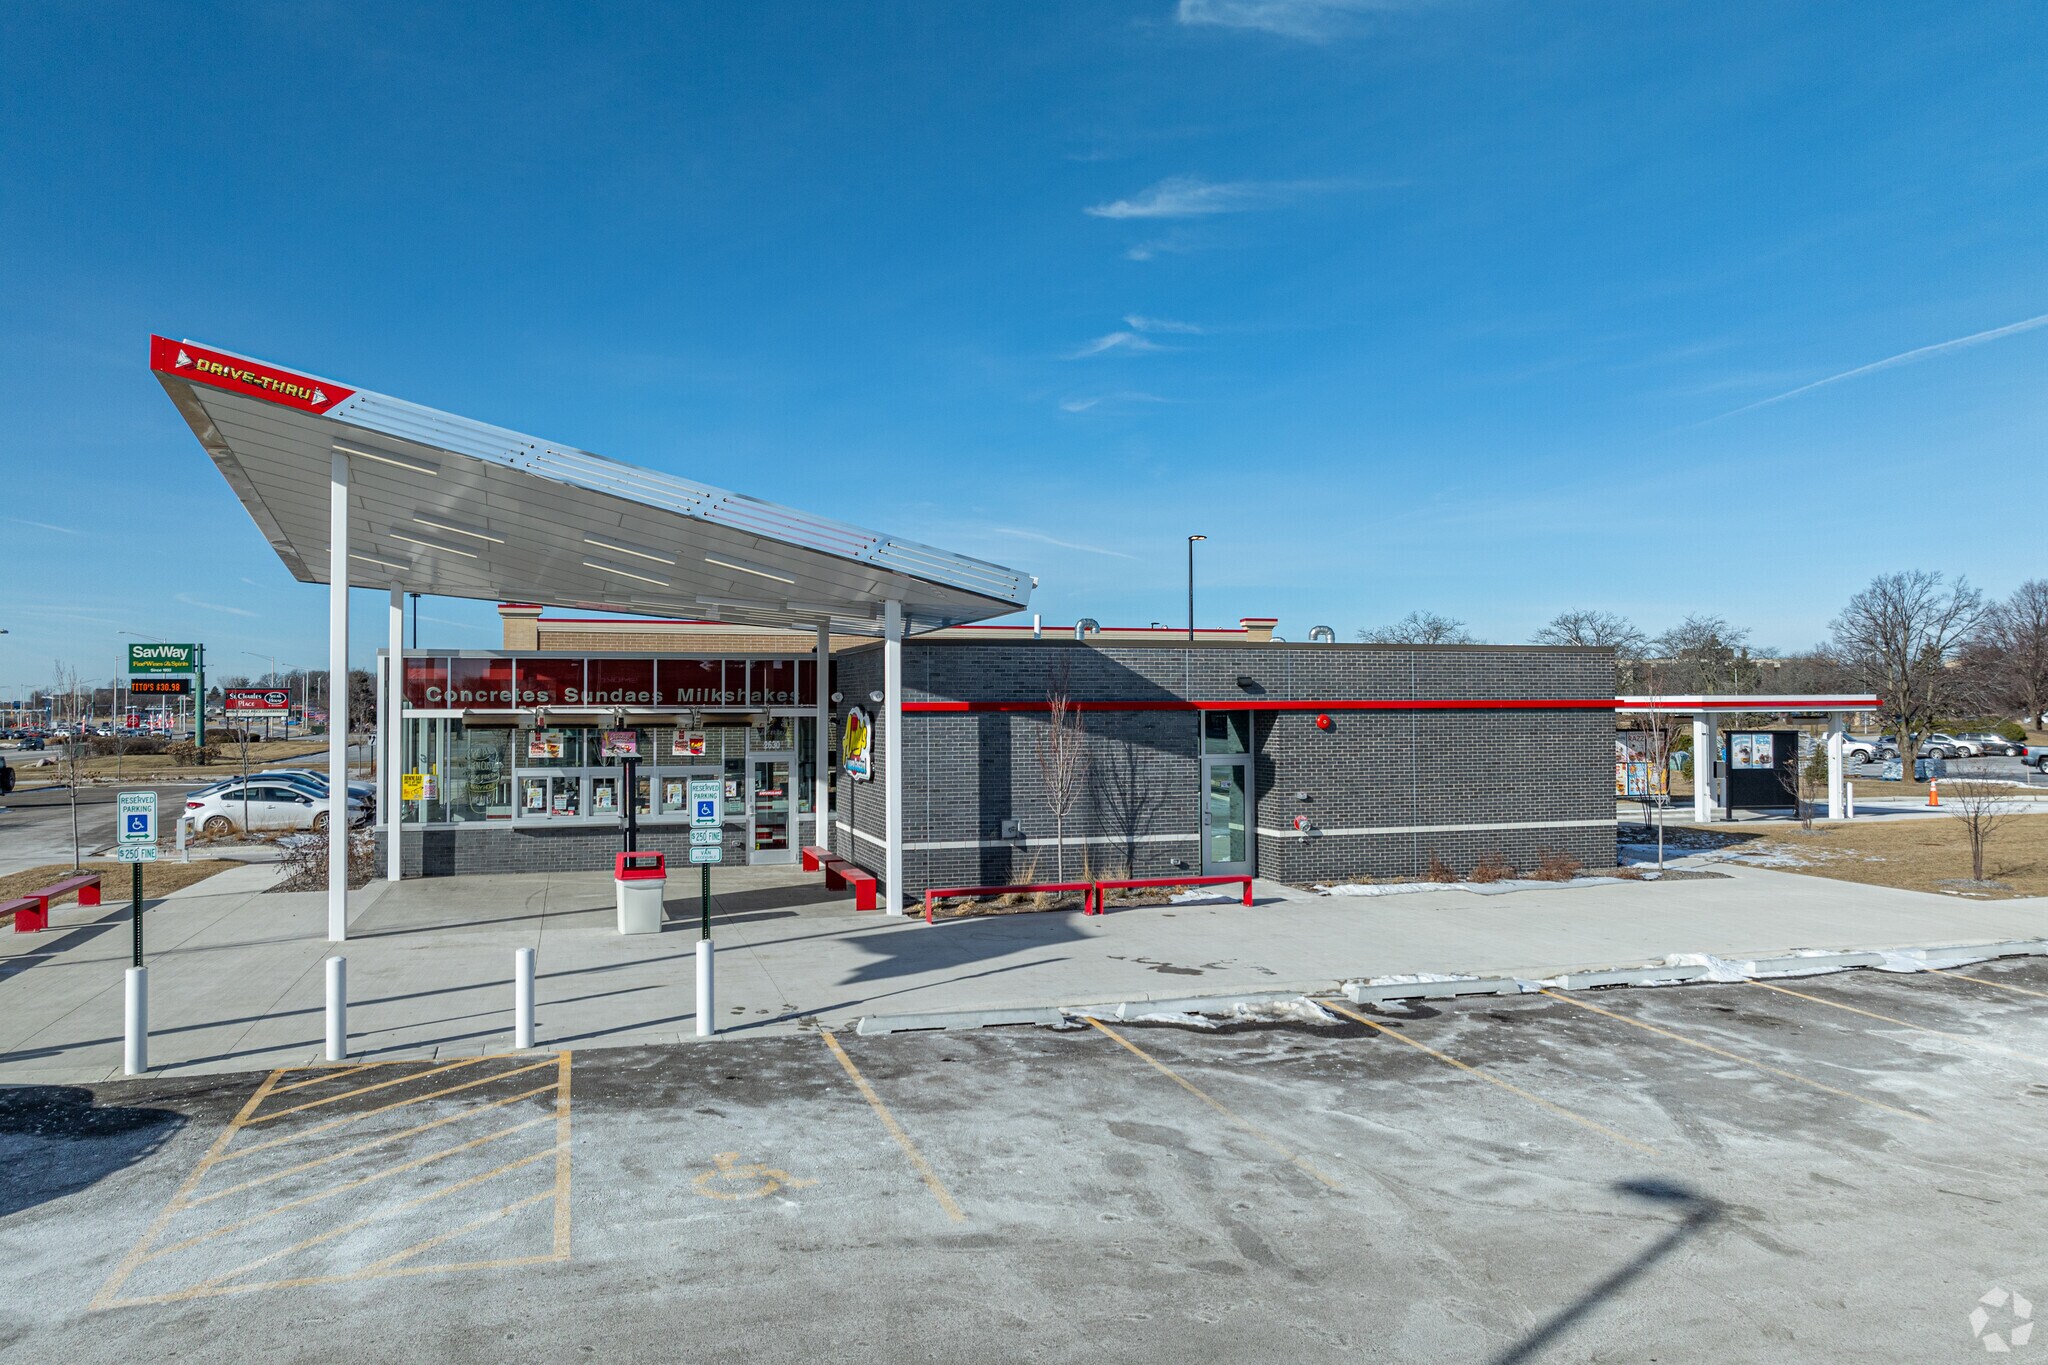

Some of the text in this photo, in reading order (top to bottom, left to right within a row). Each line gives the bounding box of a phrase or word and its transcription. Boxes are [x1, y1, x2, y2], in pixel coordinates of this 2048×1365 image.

[196, 358, 312, 400] DRIVE-THRU
[132, 645, 189, 661] SavWay
[131, 683, 181, 692] TITO'S $30.98
[237, 692, 262, 700] Charles
[426, 686, 801, 703] Concretes Sundaes Milkshakes
[121, 796, 154, 804] RESERVED
[123, 805, 152, 813] PARKING
[708, 831, 720, 841] FINE
[141, 848, 156, 859] FINE
